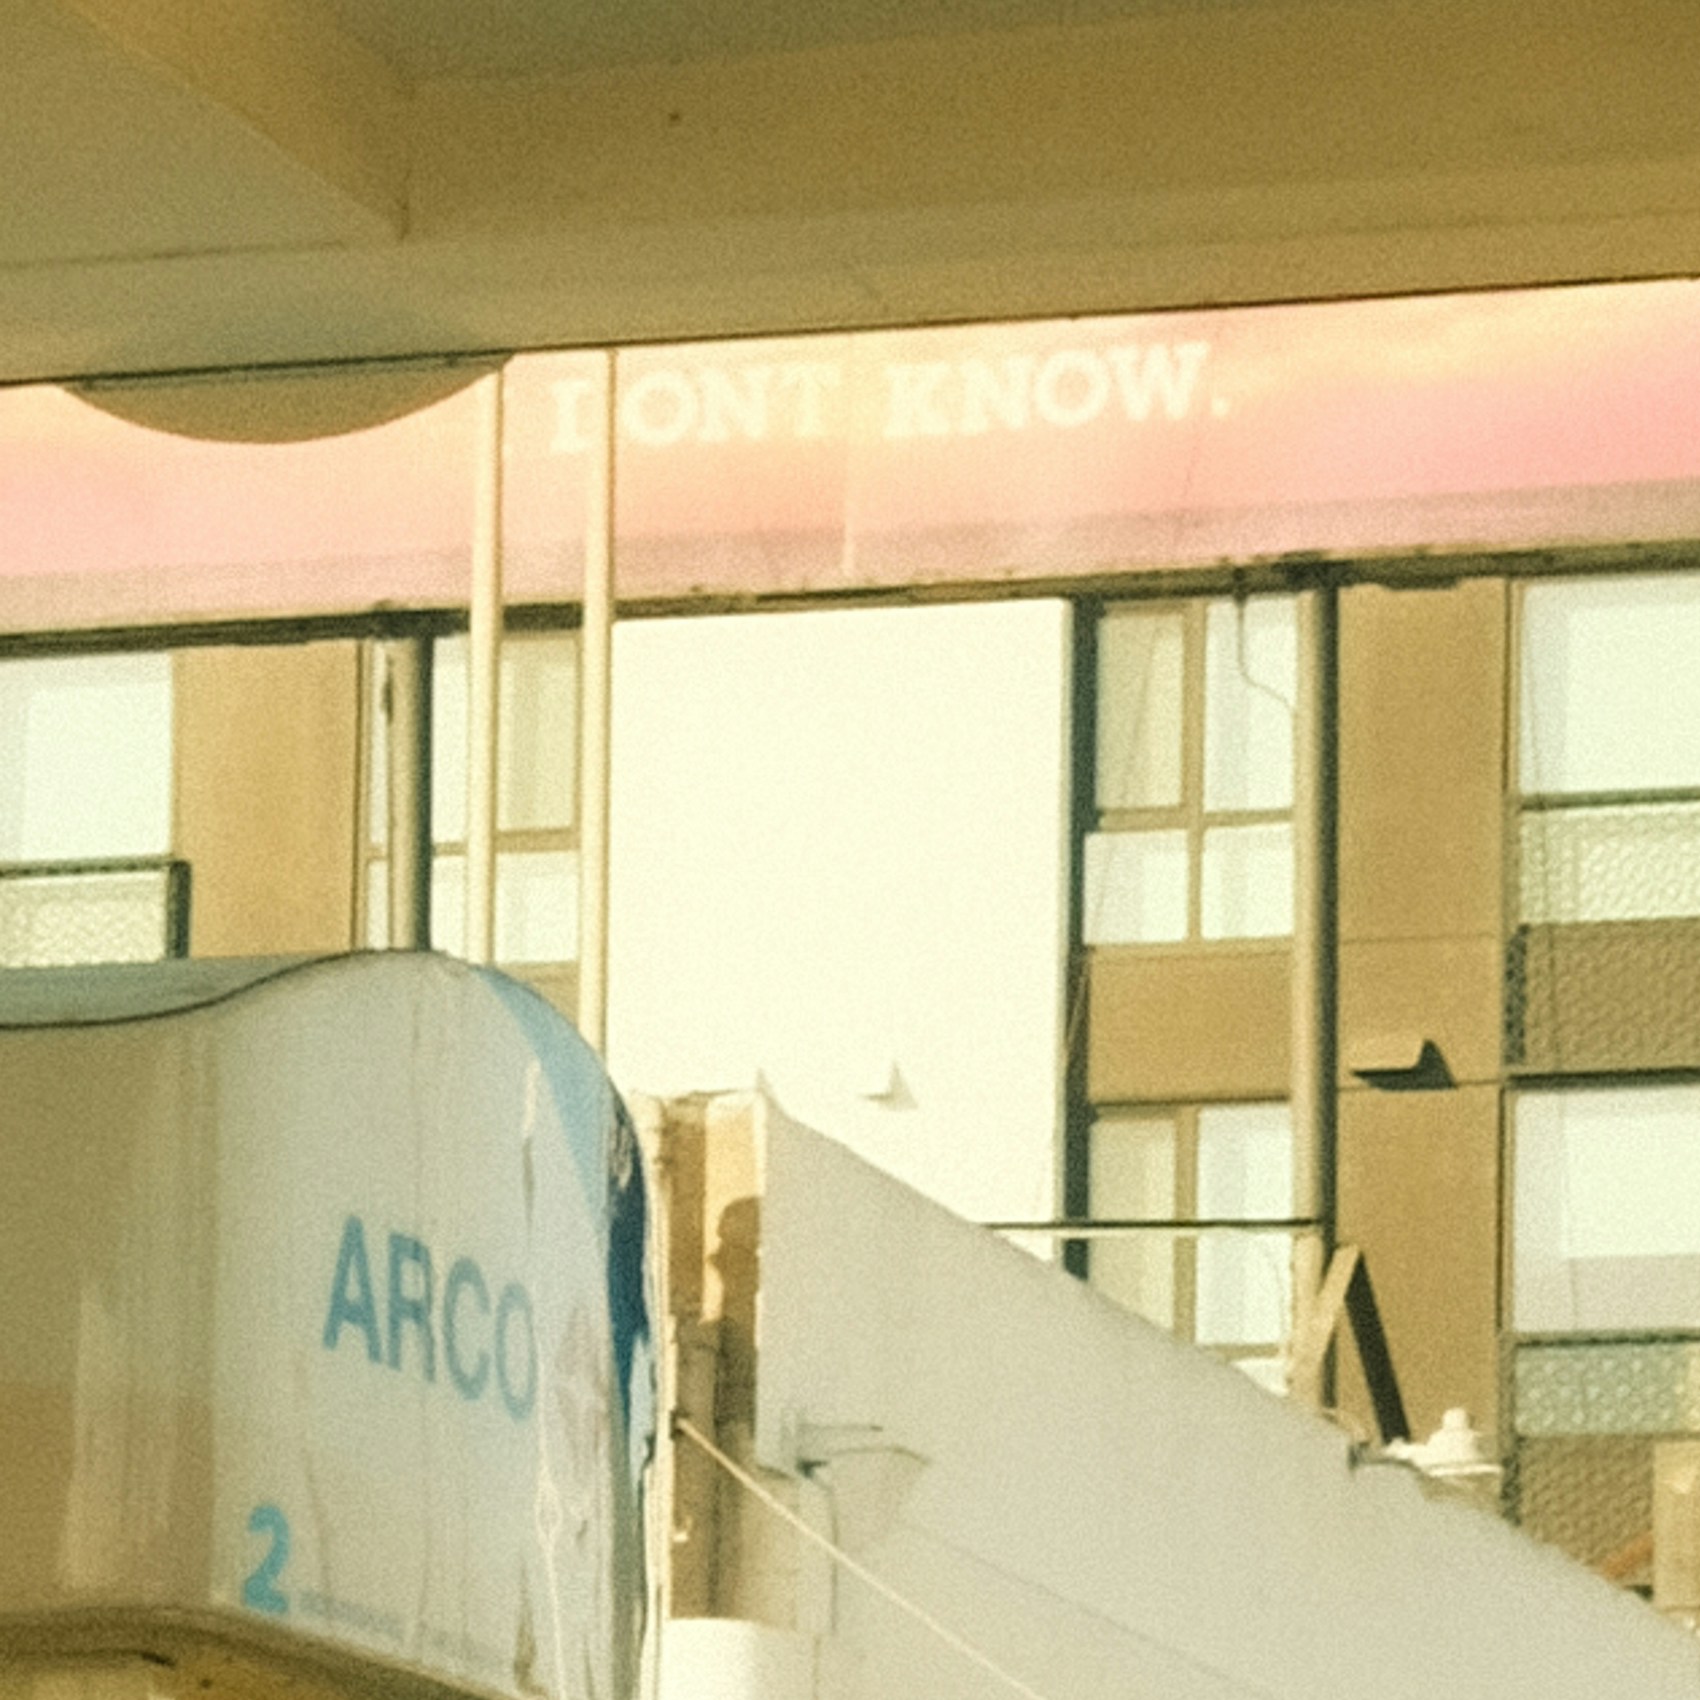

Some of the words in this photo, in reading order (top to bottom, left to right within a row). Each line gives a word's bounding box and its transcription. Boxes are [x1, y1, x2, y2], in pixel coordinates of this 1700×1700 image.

[882, 339, 1231, 438] KNOW.
[322, 1215, 538, 1421] ARCO
[243, 1504, 290, 1614] 2
